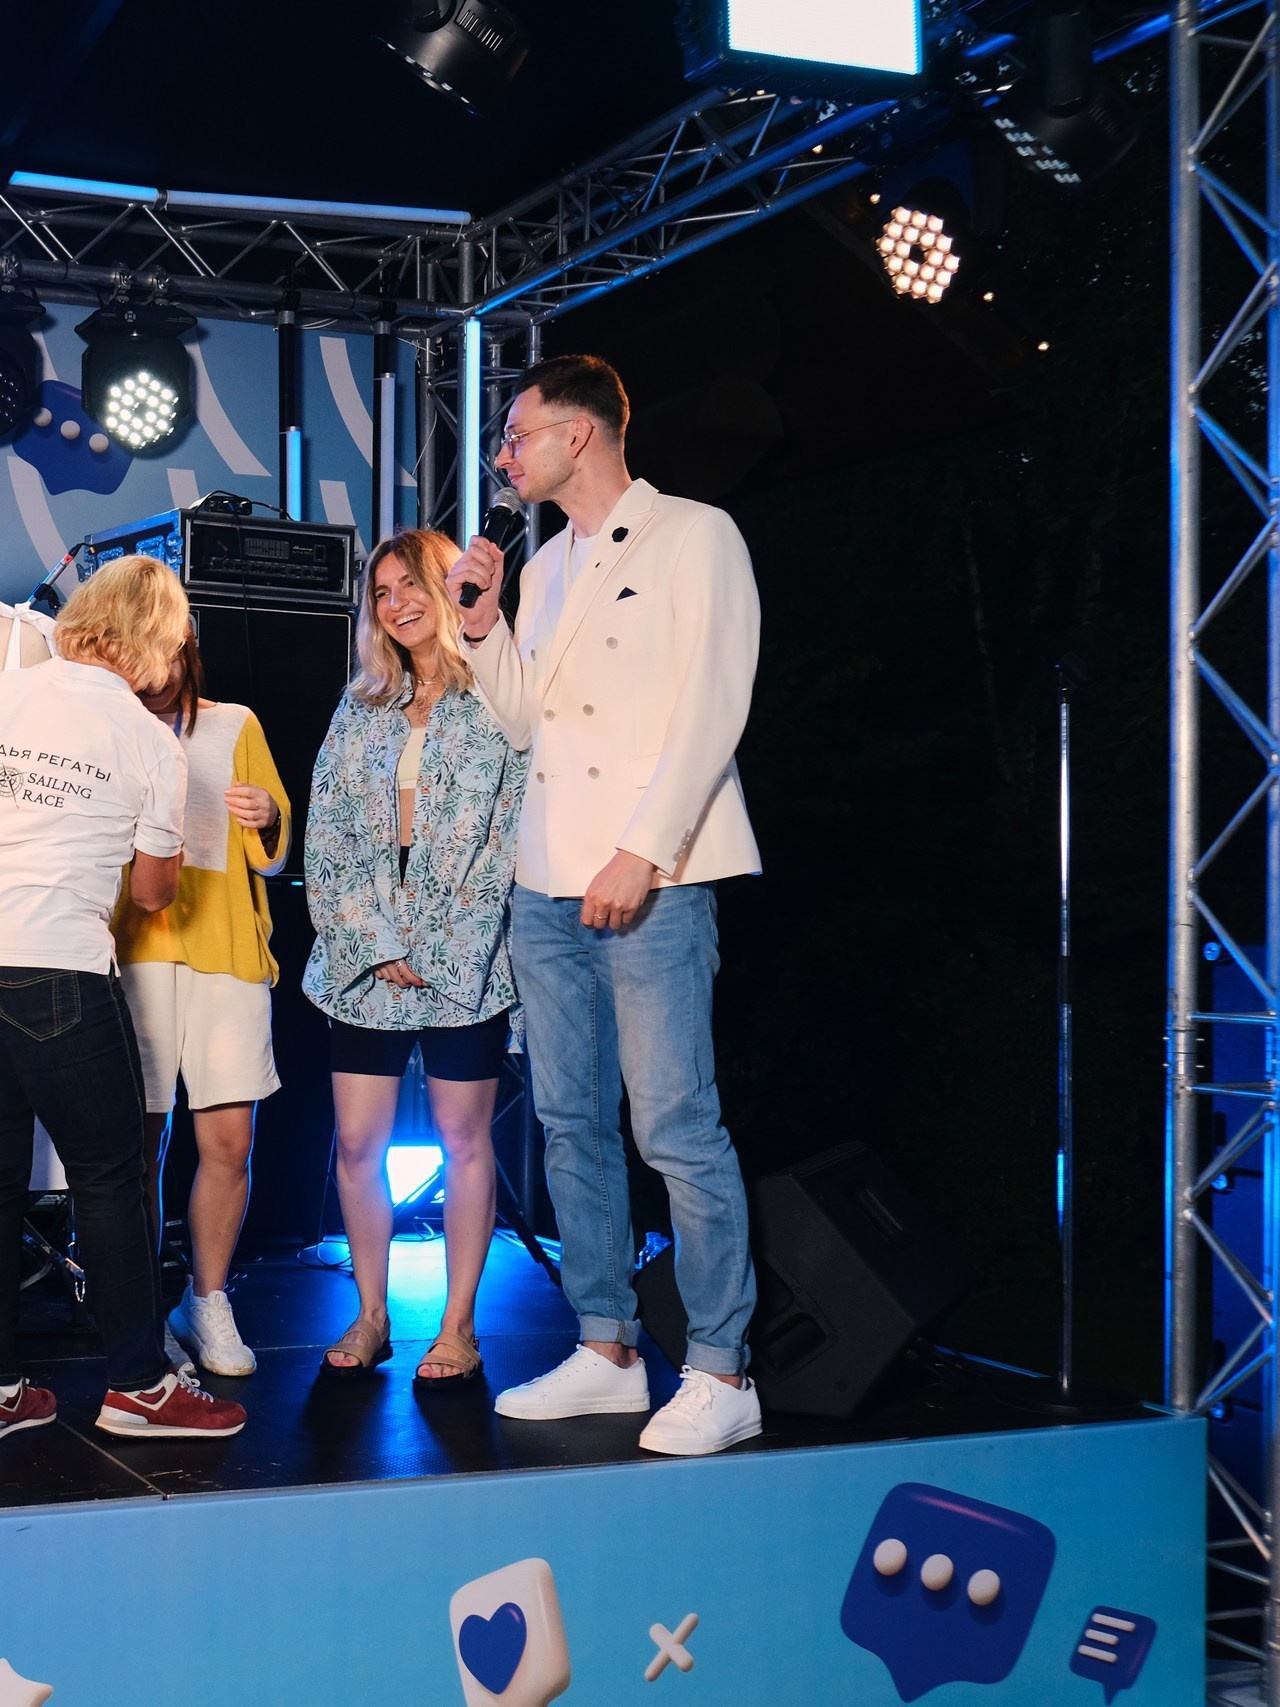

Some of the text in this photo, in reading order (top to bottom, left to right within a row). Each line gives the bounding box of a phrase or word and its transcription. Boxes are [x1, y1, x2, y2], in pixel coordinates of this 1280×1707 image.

[37, 752, 112, 782] РЕГАТЫ
[27, 772, 92, 799] SAILING
[22, 790, 65, 809] RACE
